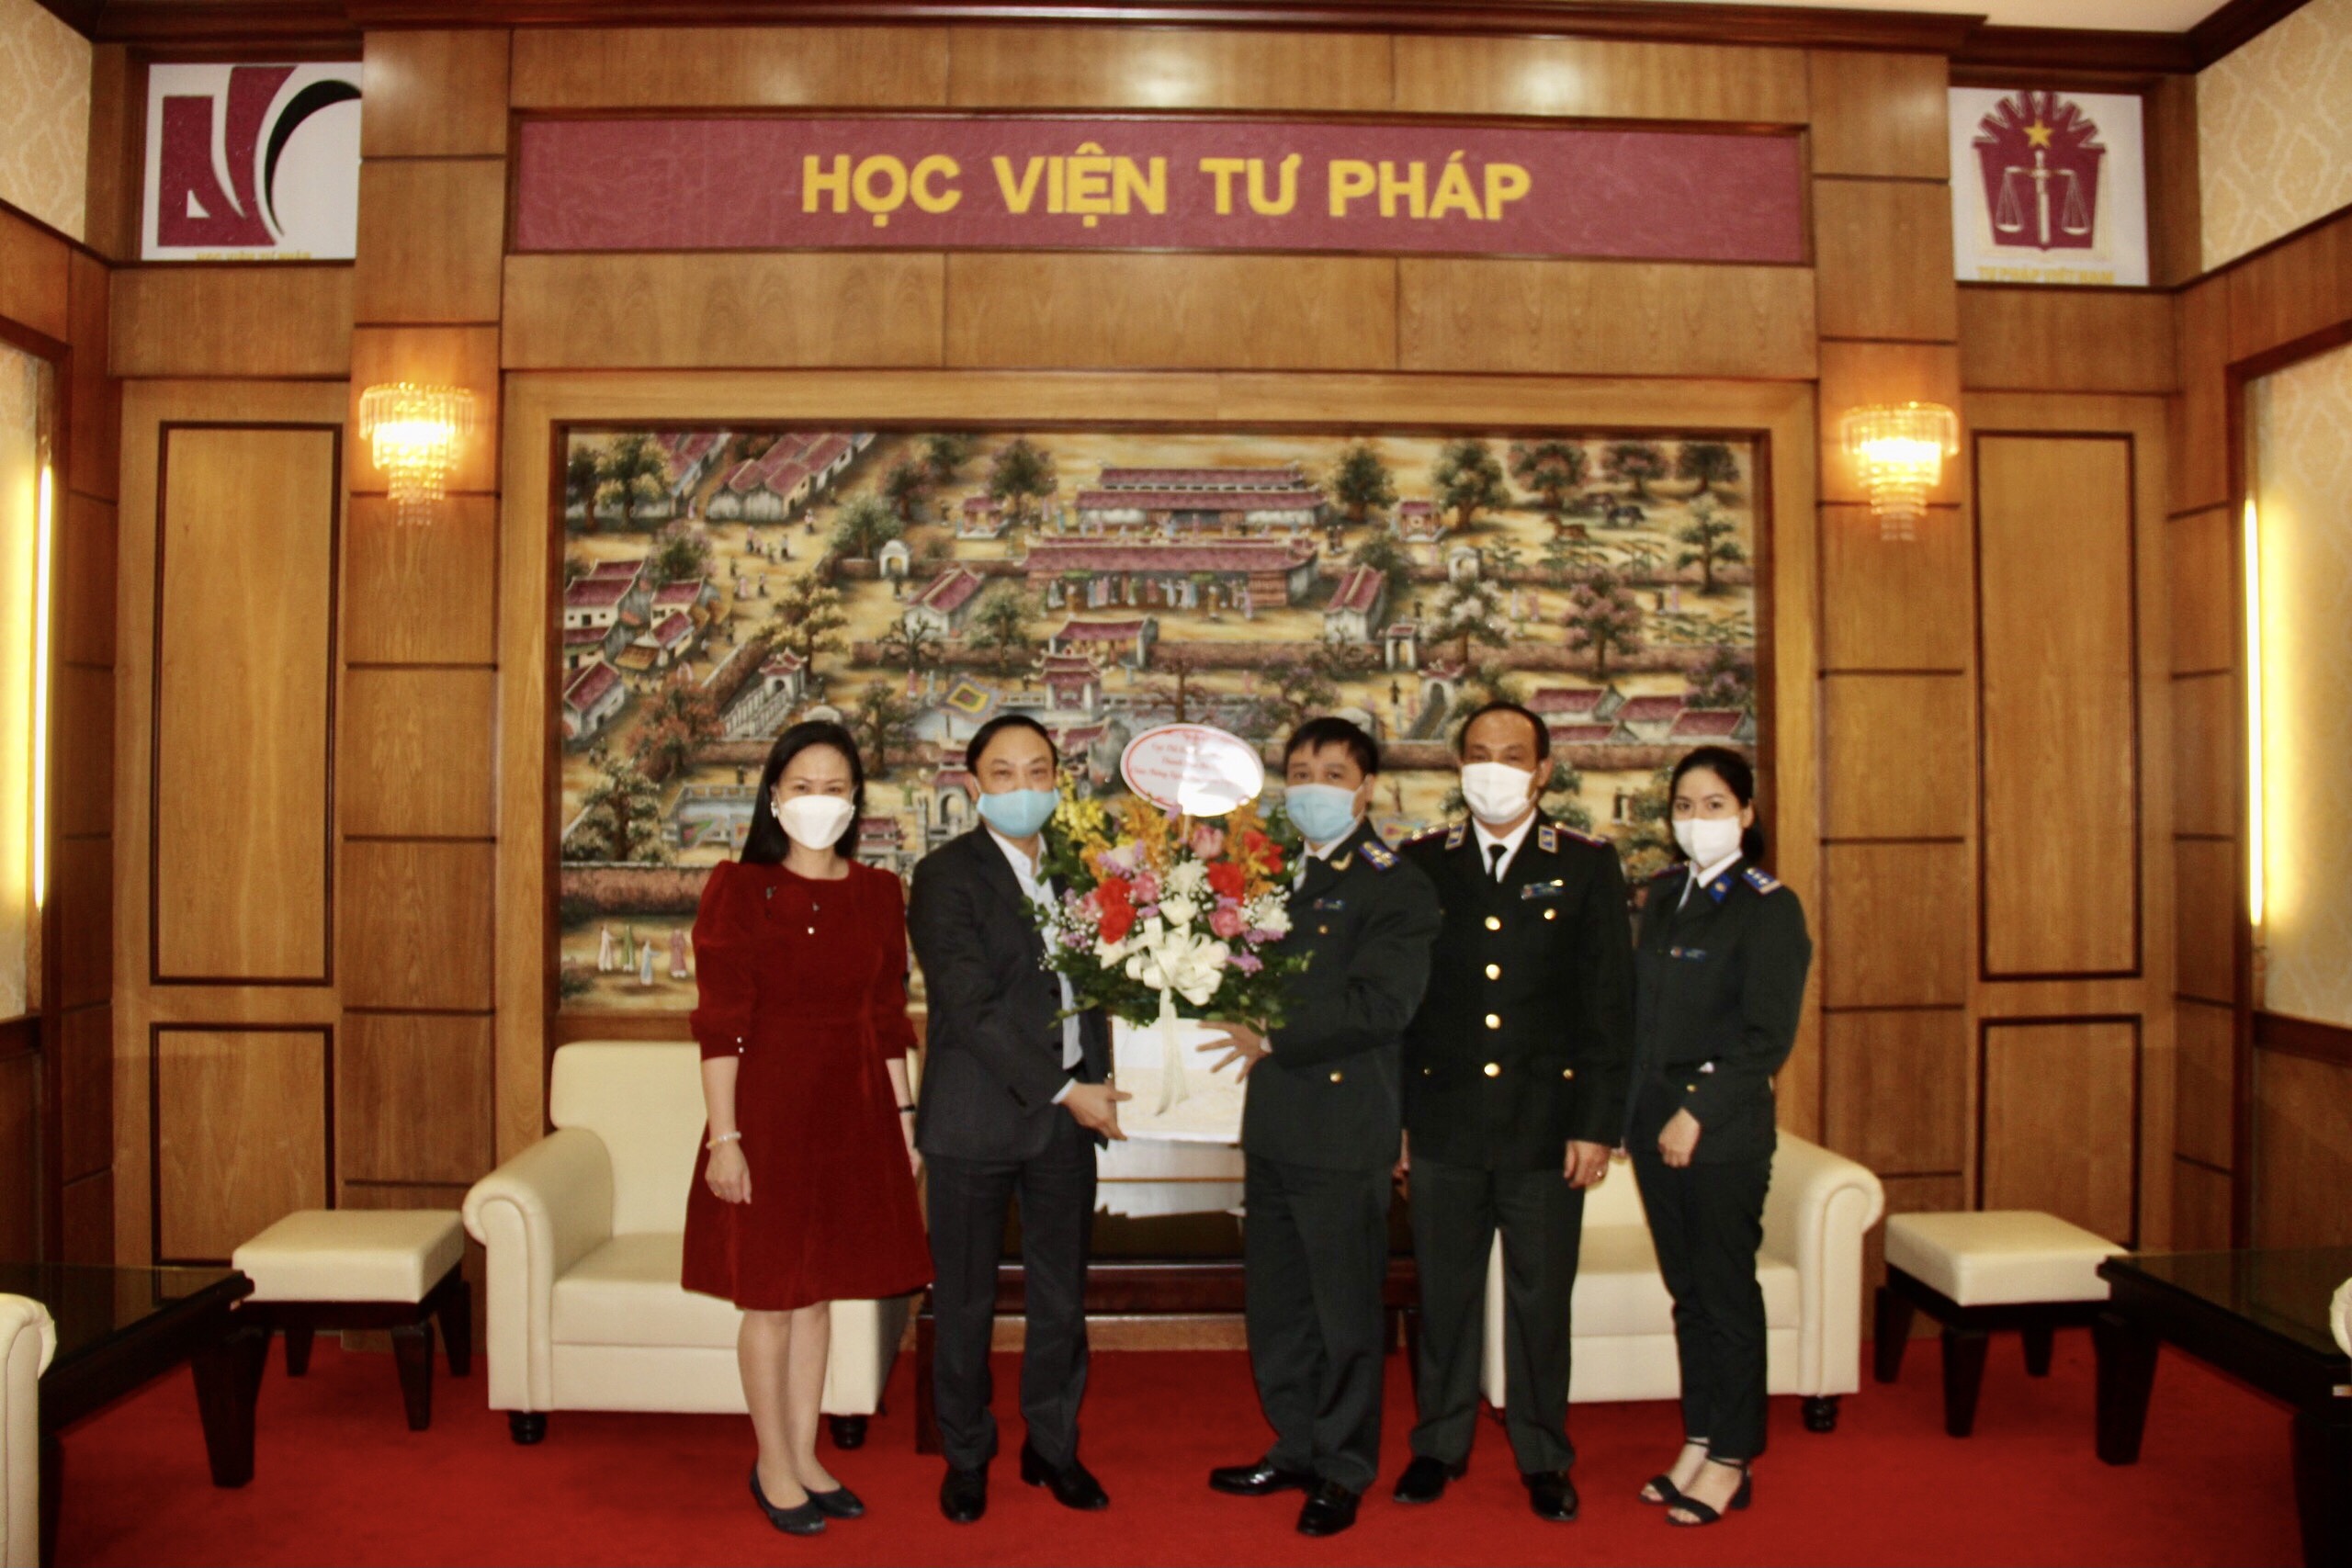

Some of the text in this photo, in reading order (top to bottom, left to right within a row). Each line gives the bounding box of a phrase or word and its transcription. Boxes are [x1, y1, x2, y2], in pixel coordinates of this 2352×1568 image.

[802, 141, 1532, 227] HỌC VIỆN TƯ PHÁP
